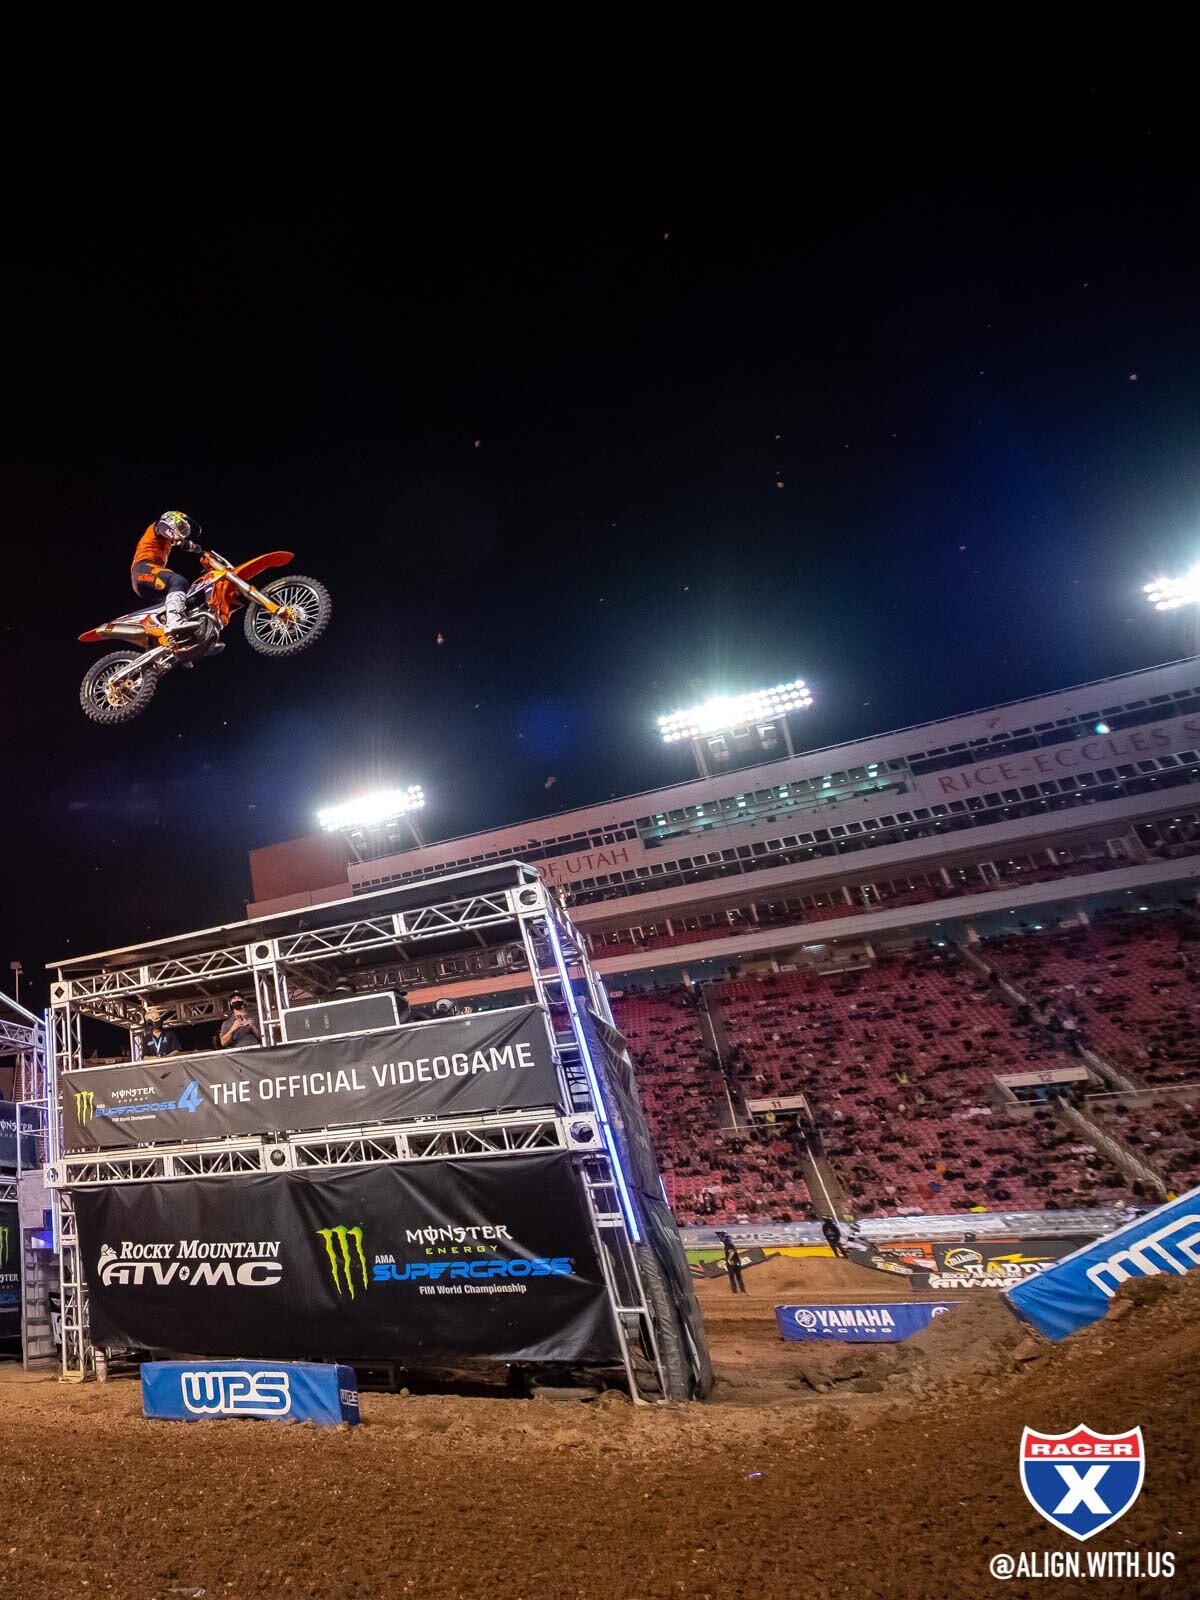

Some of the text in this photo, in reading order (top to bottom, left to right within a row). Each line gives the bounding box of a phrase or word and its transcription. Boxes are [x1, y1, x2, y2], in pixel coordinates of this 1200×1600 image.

[937, 726, 1171, 794] RICE-ECCLES
[565, 848, 630, 873] UTAH
[209, 1042, 536, 1105] THE OFFICIAL VIDEOGAME
[95, 1080, 204, 1118] SUPERCROSS 4
[111, 1087, 156, 1099] MONSTER
[771, 1101, 782, 1109] 11
[405, 1224, 514, 1246] MONSTER
[120, 1239, 281, 1260] ROCKY MOUNTAIN
[375, 1255, 395, 1264] AMA
[425, 1245, 498, 1255] ENERGY
[372, 1257, 573, 1281] SUPERCROSS
[419, 1283, 527, 1295] FIM World Championship
[815, 1309, 895, 1327] YAMAHA
[181, 1371, 292, 1415] WPS
